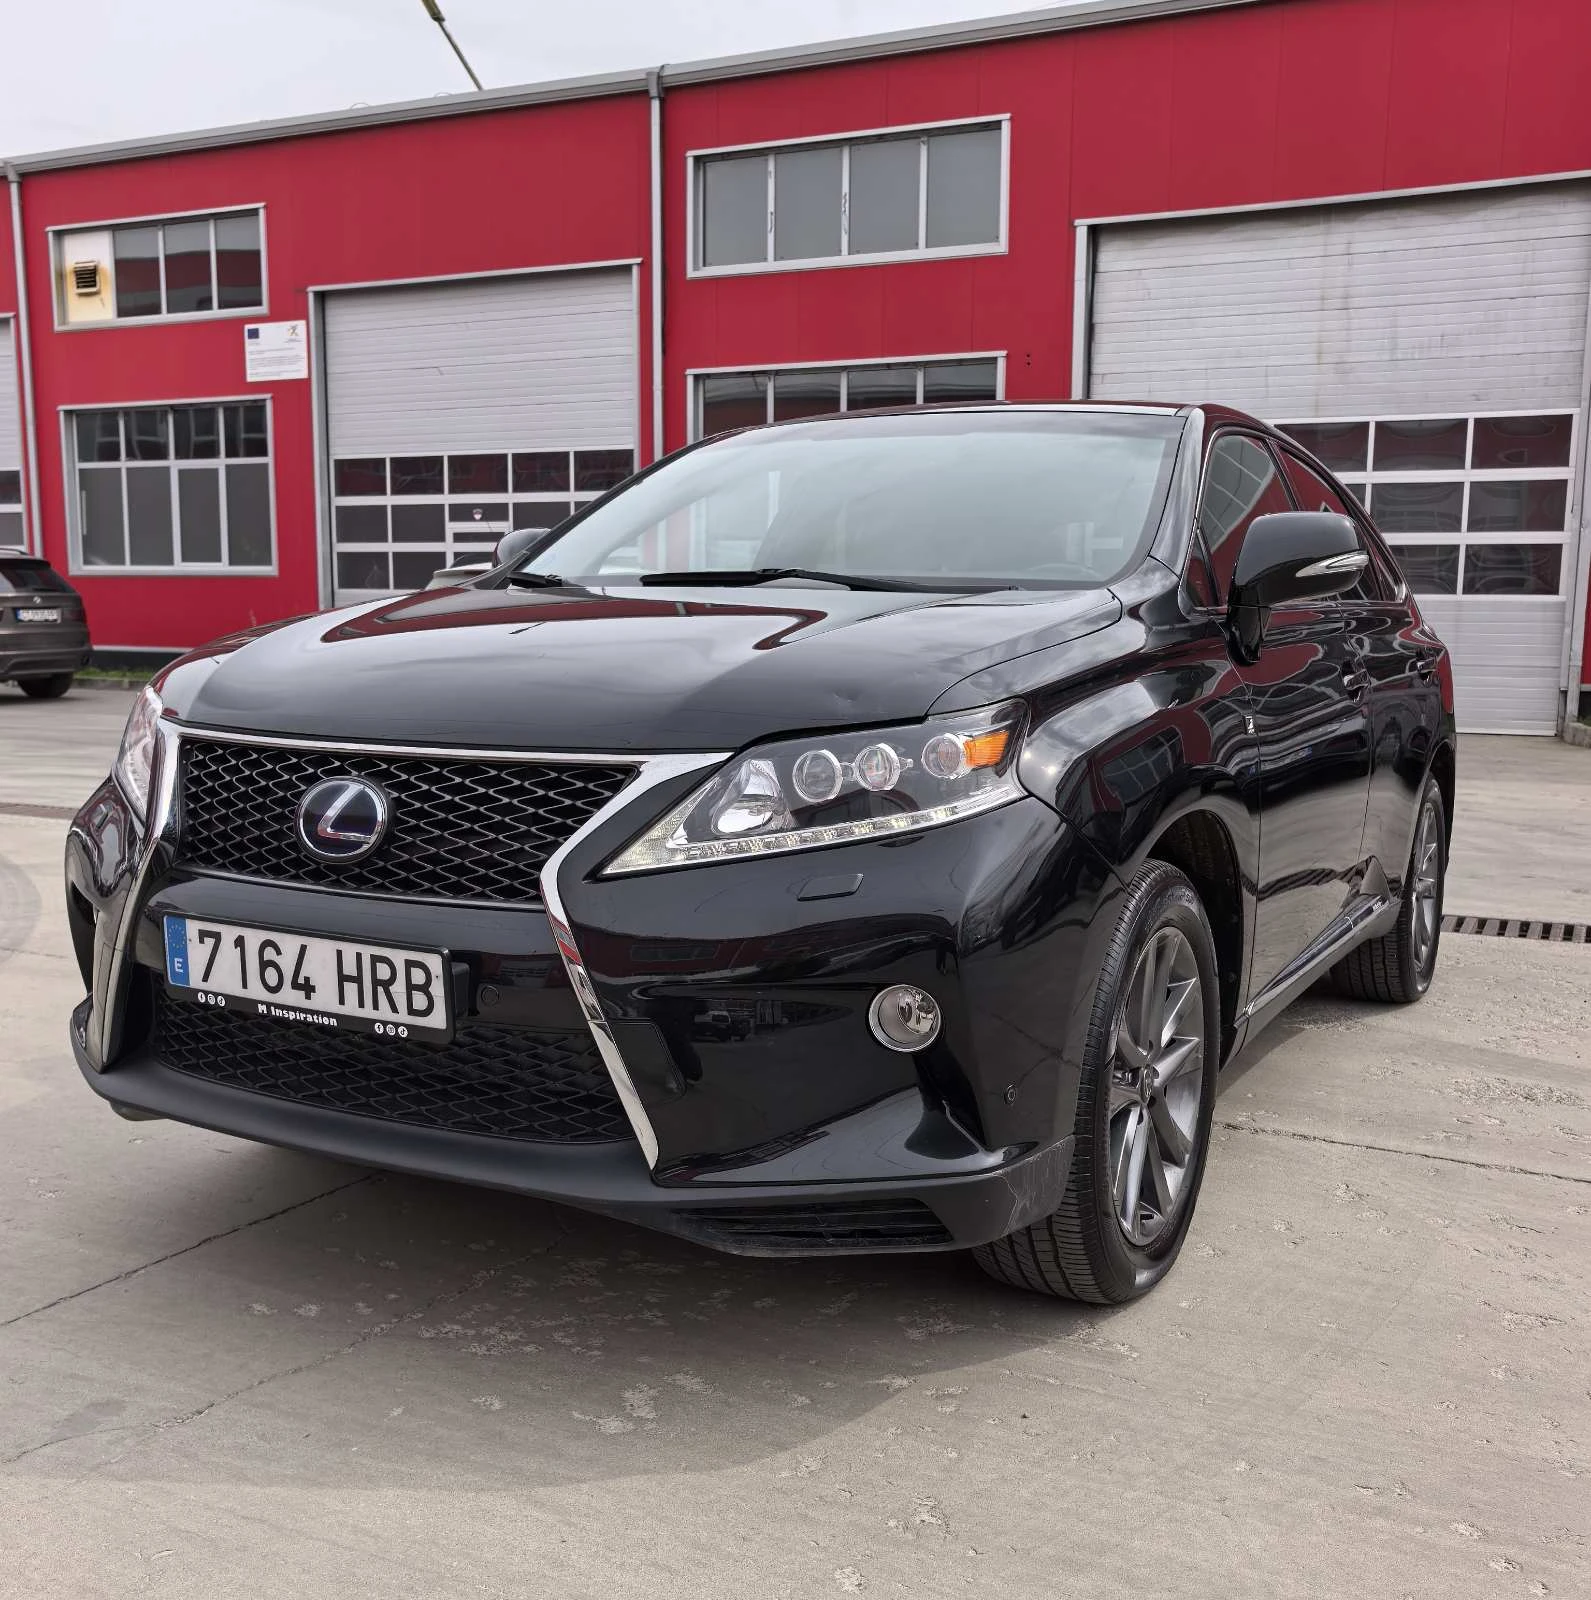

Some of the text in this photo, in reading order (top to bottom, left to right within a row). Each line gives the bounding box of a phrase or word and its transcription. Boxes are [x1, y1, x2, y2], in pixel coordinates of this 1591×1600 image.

[174, 957, 184, 973] E
[197, 928, 434, 1019] 7164 HRB
[257, 1003, 338, 1027] M Inspiration
